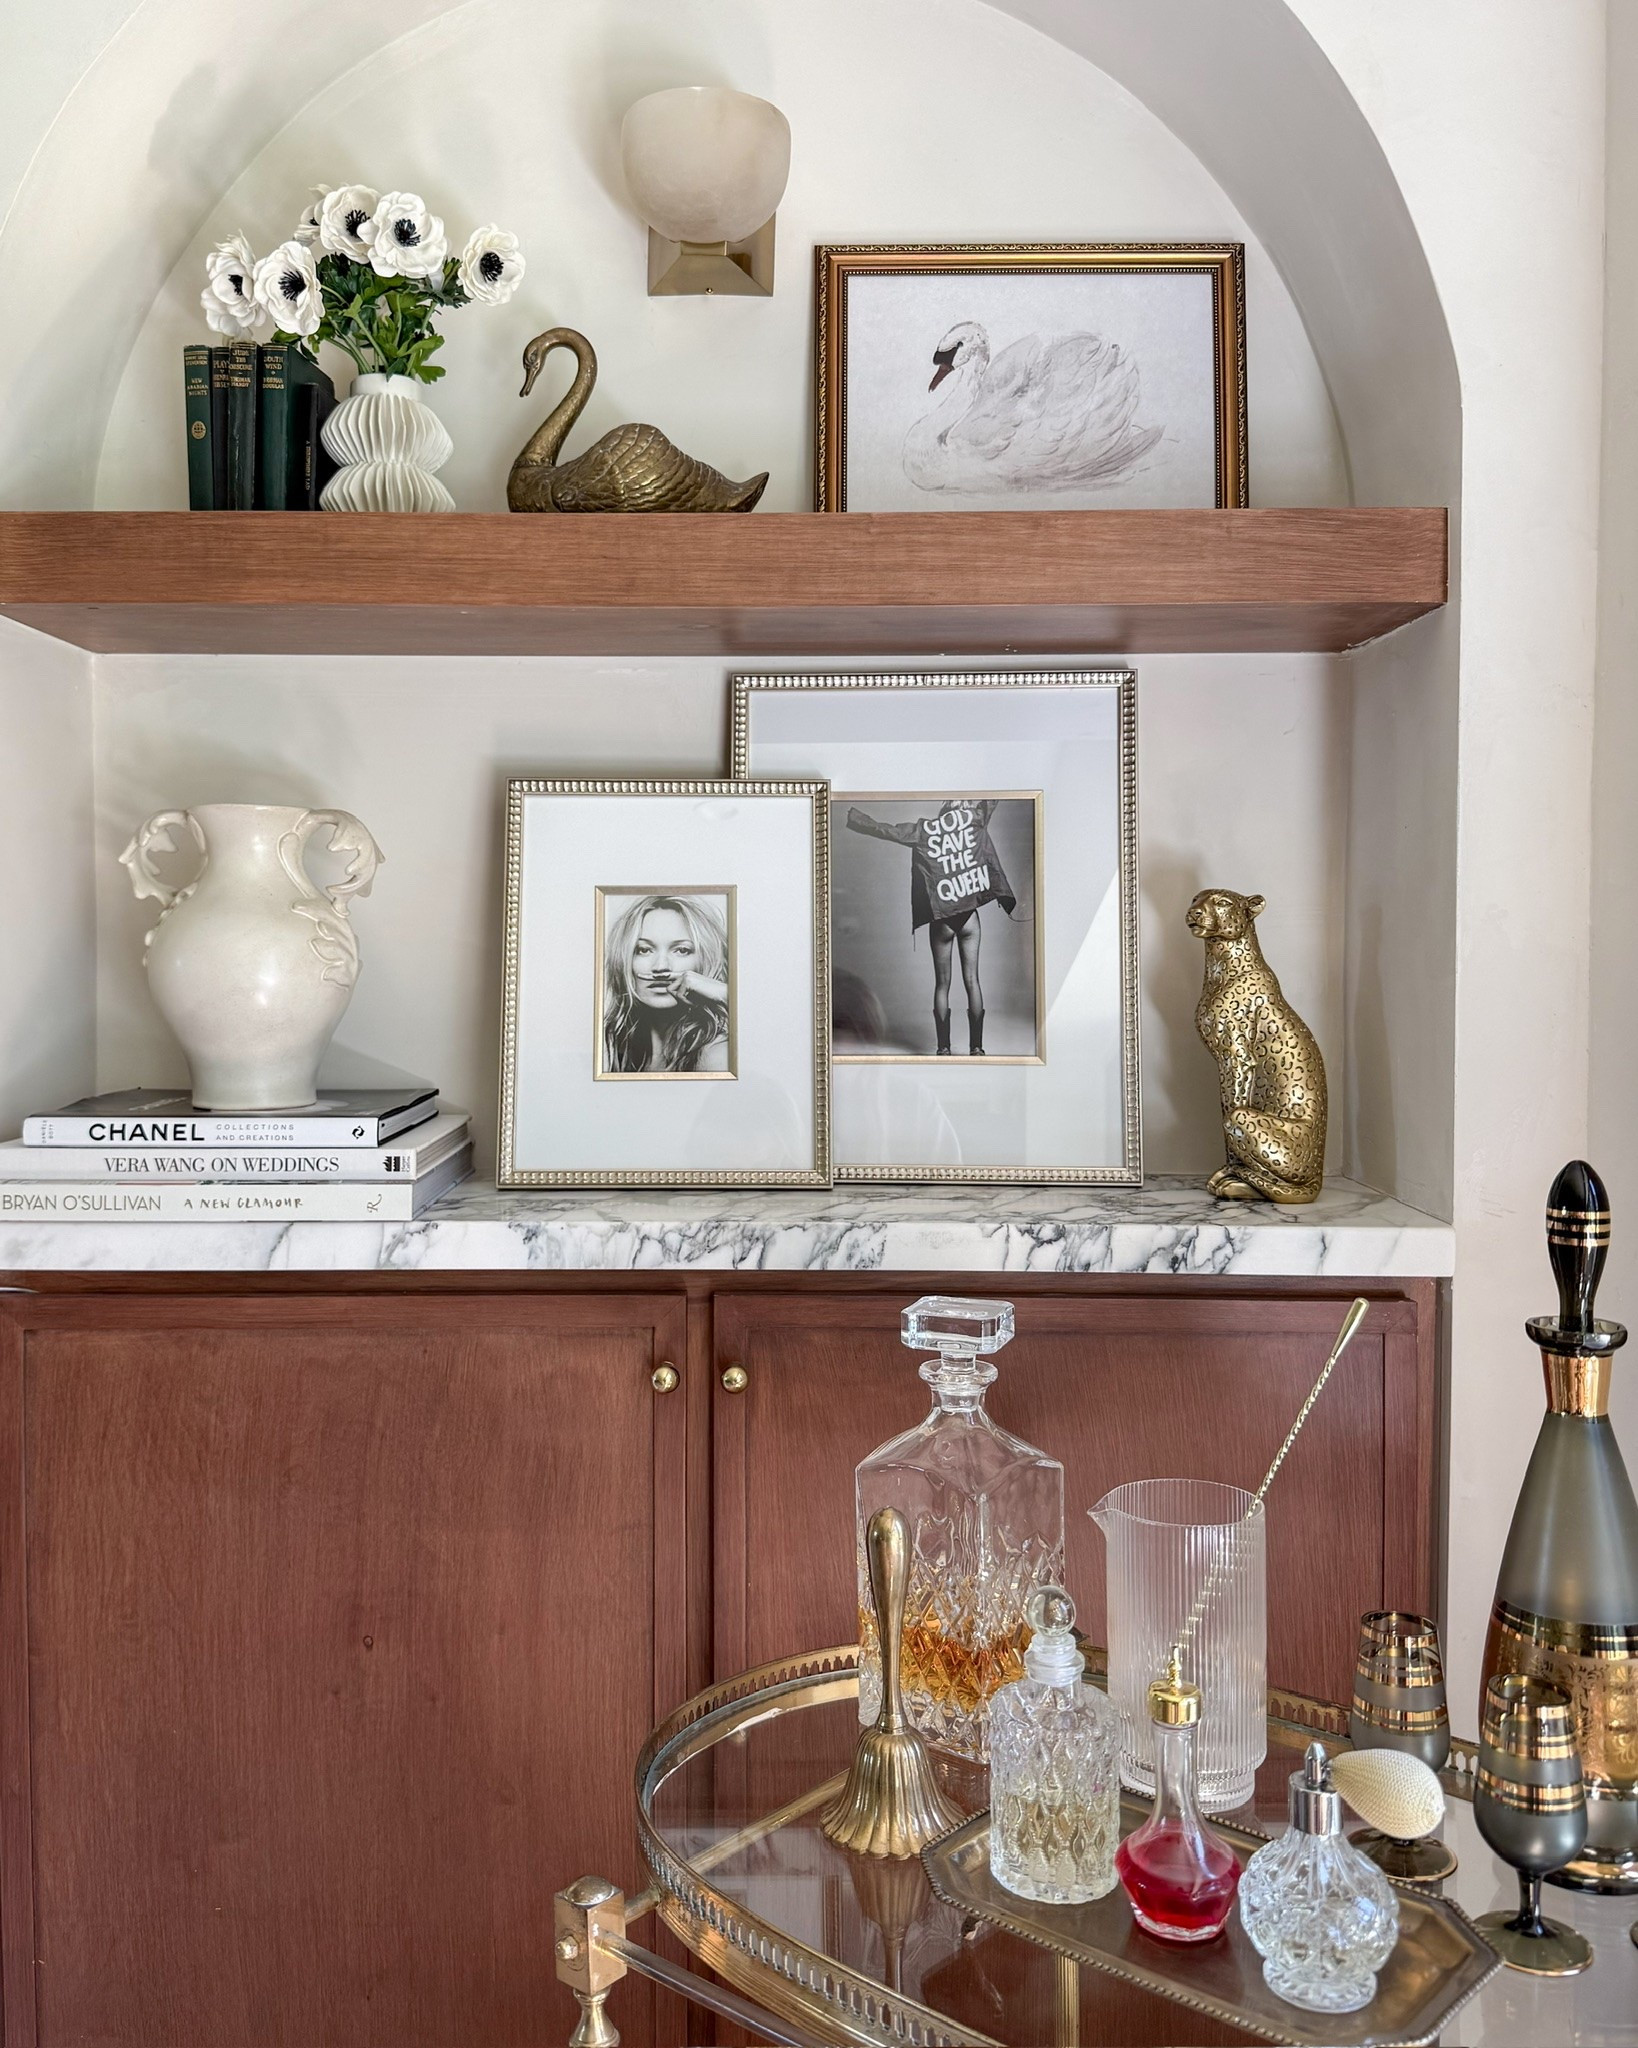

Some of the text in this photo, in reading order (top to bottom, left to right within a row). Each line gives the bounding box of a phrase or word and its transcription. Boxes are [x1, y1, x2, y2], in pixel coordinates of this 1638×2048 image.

[923, 809, 973, 835] GOD
[927, 827, 977, 858] SAVE
[937, 849, 978, 875] THE
[936, 864, 991, 902] QUEEN
[88, 1122, 205, 1141] CHANEL
[216, 1123, 295, 1131] COLLECTIONS
[104, 1157, 340, 1173] VERA WANG ON WEDDINGS
[2, 1194, 161, 1211] BRYAN O'SULLIVAN
[184, 1197, 304, 1209] A NEW GLAMOUR
